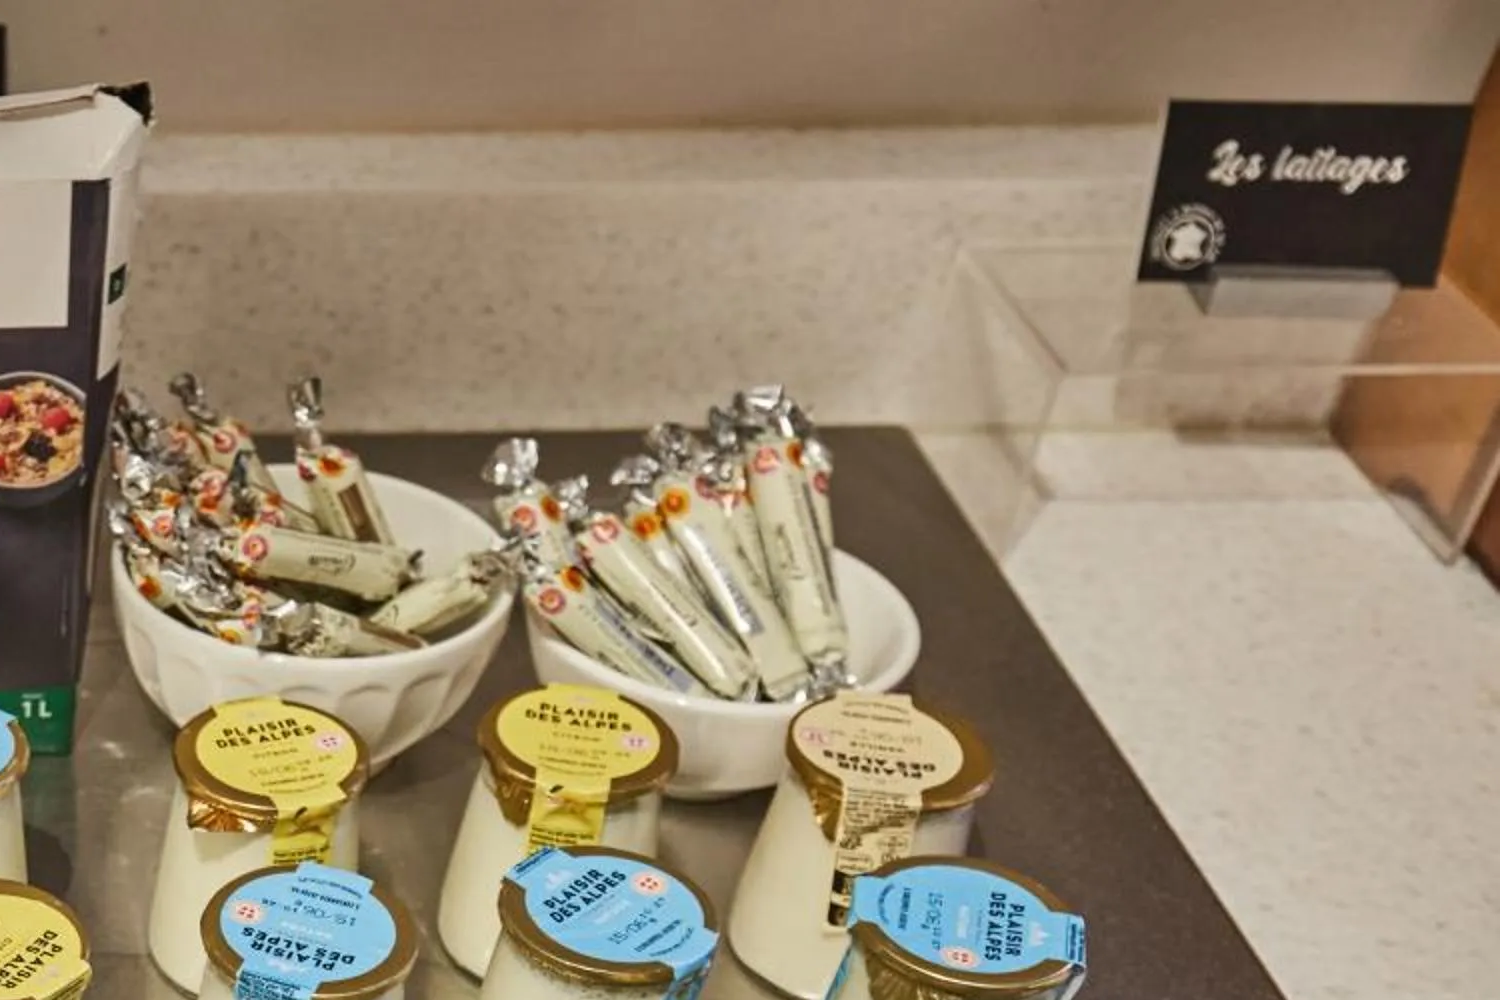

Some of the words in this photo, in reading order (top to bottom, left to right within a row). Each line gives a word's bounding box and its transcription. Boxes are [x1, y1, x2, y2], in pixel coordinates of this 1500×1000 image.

[1206, 138, 1265, 187] Les
[1270, 144, 1409, 195] laitages
[21, 700, 32, 718] 1
[38, 700, 53, 718] L
[525, 708, 563, 723] DES
[568, 717, 633, 732] ALPES
[539, 702, 620, 721] PLAISIR
[215, 736, 253, 749] DES
[258, 724, 317, 744] ALPES
[222, 717, 298, 738] PLAISIR
[542, 868, 604, 909] PLAISIR
[549, 902, 583, 924] DES
[580, 870, 627, 906] ALPES
[990, 891, 1008, 919] DES
[241, 926, 309, 951] ALPES
[984, 921, 1003, 962] ALPES
[1004, 903, 1026, 957] PLAISIR
[2, 944, 63, 990] PLAISIR
[250, 941, 336, 971] PLAISIR
[315, 949, 356, 965] DES
